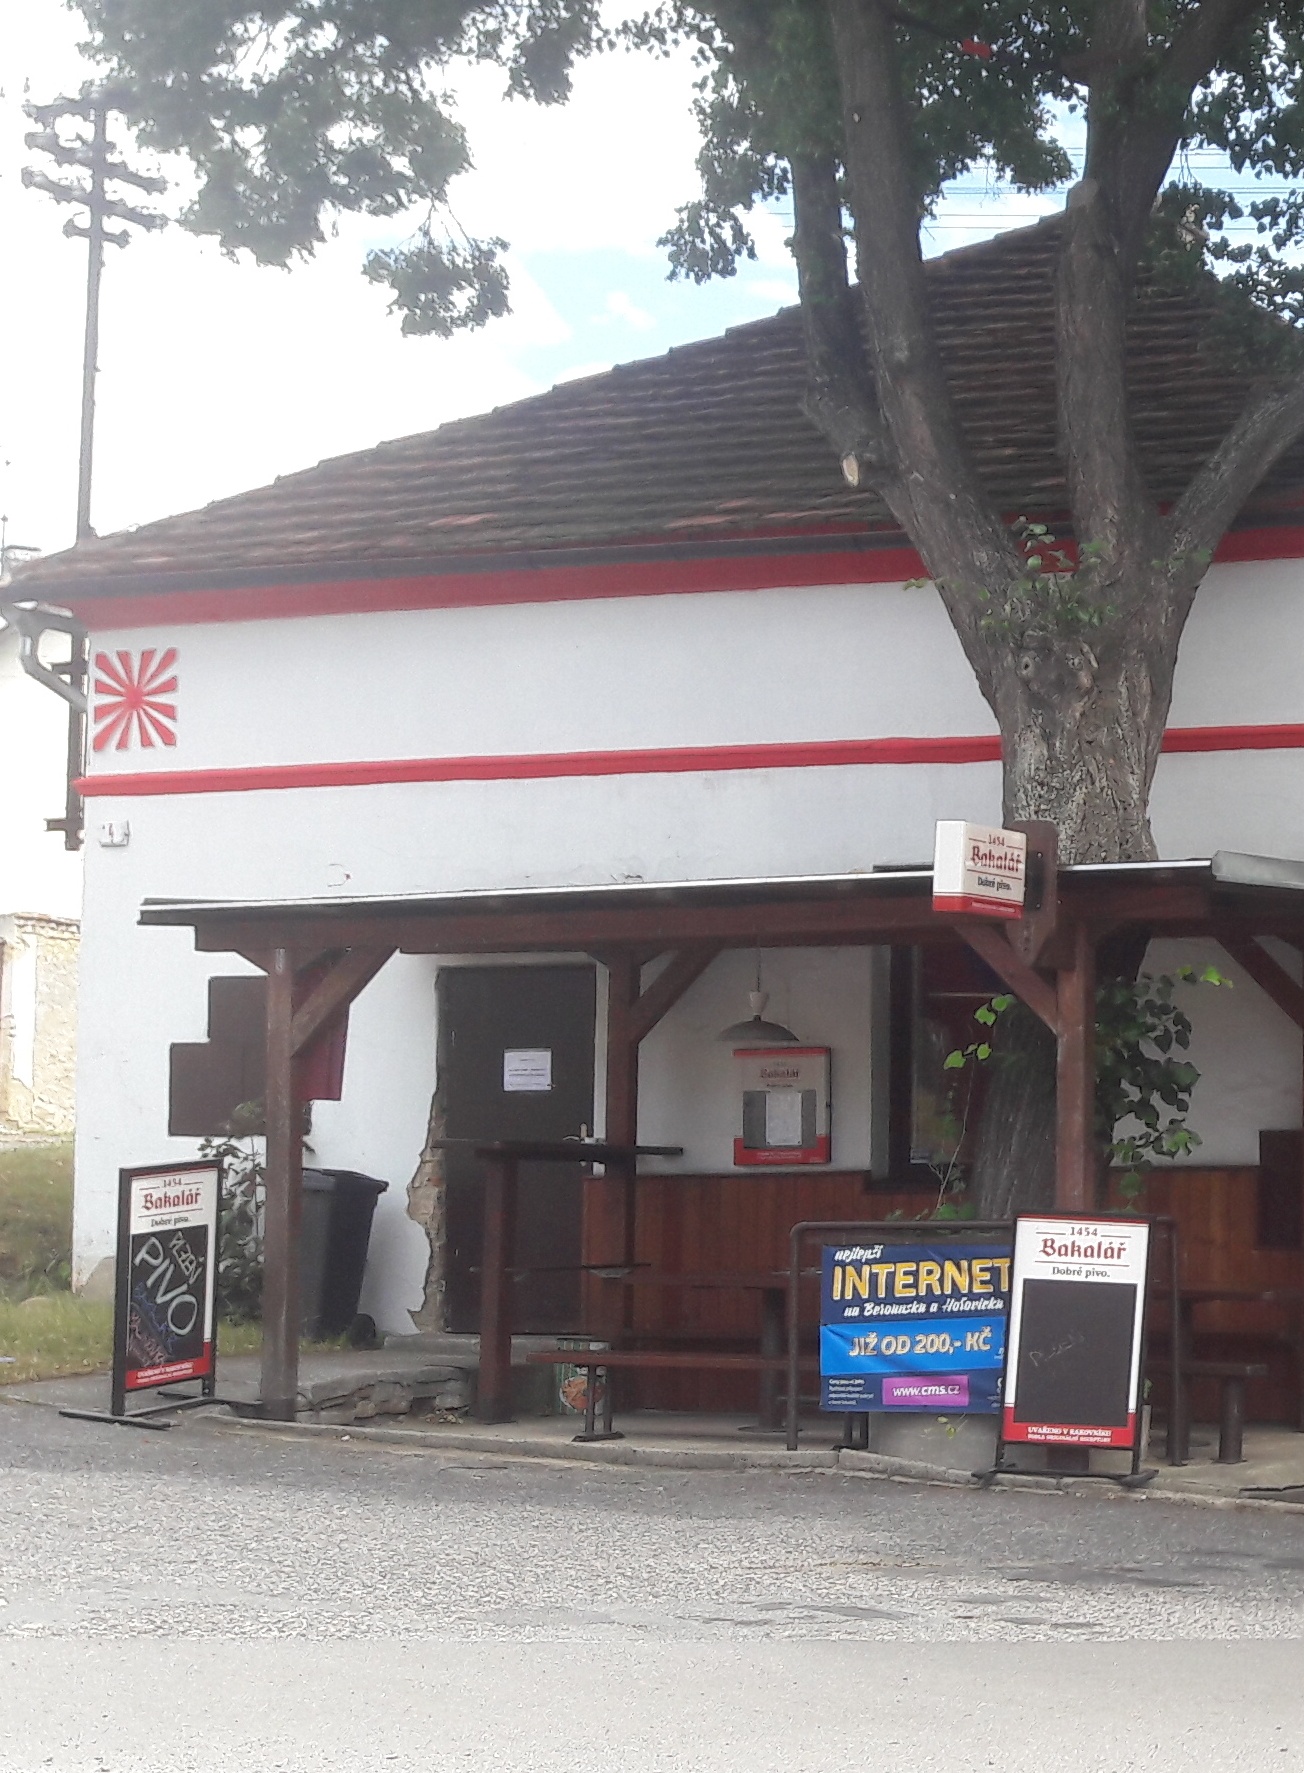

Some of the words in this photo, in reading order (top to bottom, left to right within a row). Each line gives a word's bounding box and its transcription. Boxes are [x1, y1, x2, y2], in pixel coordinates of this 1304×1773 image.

[970, 845, 1024, 872] Bakalář
[142, 1188, 202, 1211] Bakalář
[1070, 1226, 1098, 1236] 1454
[834, 1244, 883, 1262] nejlepší
[1039, 1238, 1127, 1260] Bakalář
[832, 1257, 1011, 1300] INTERNET
[1052, 1266, 1083, 1277] Dobré
[1085, 1267, 1111, 1279] pivo.
[133, 1236, 198, 1336] PIVO
[843, 1305, 860, 1317] na
[929, 1302, 938, 1313] a
[849, 1331, 878, 1357] JIŽ
[880, 1335, 911, 1355] OD
[913, 1332, 962, 1355] 200,-
[964, 1326, 993, 1352] KČ
[892, 1384, 961, 1398] www.cms.cz
